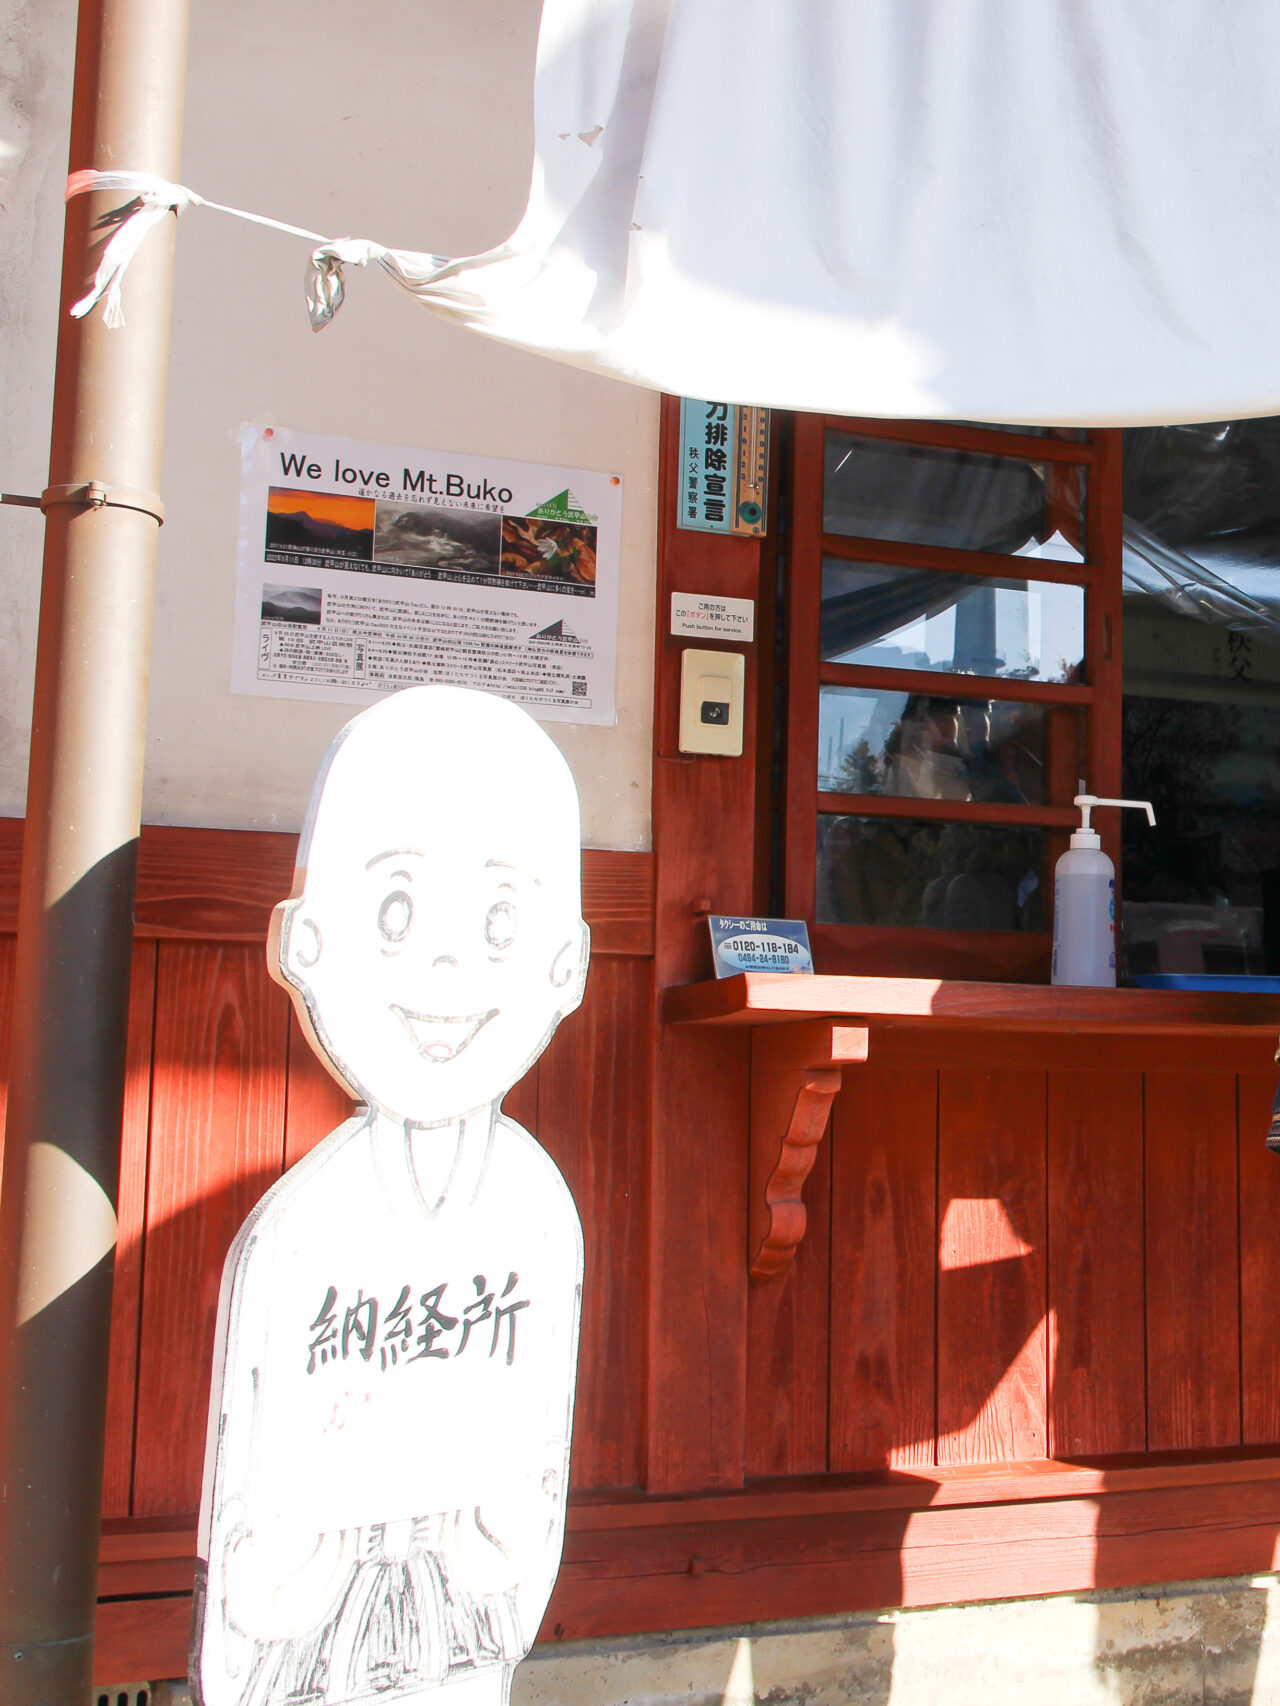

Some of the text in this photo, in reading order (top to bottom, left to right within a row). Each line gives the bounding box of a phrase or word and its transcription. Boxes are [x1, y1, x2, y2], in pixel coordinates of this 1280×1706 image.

[280, 452, 513, 503] We love Mt.Buko
[687, 446, 699, 519] 秩父警察署
[261, 633, 270, 662] ライヴ
[719, 919, 768, 932] タクシーのご用命は
[732, 940, 799, 954] 0120-118-184
[738, 952, 790, 965] 0494-24-8180
[306, 1271, 531, 1376] 納経所
